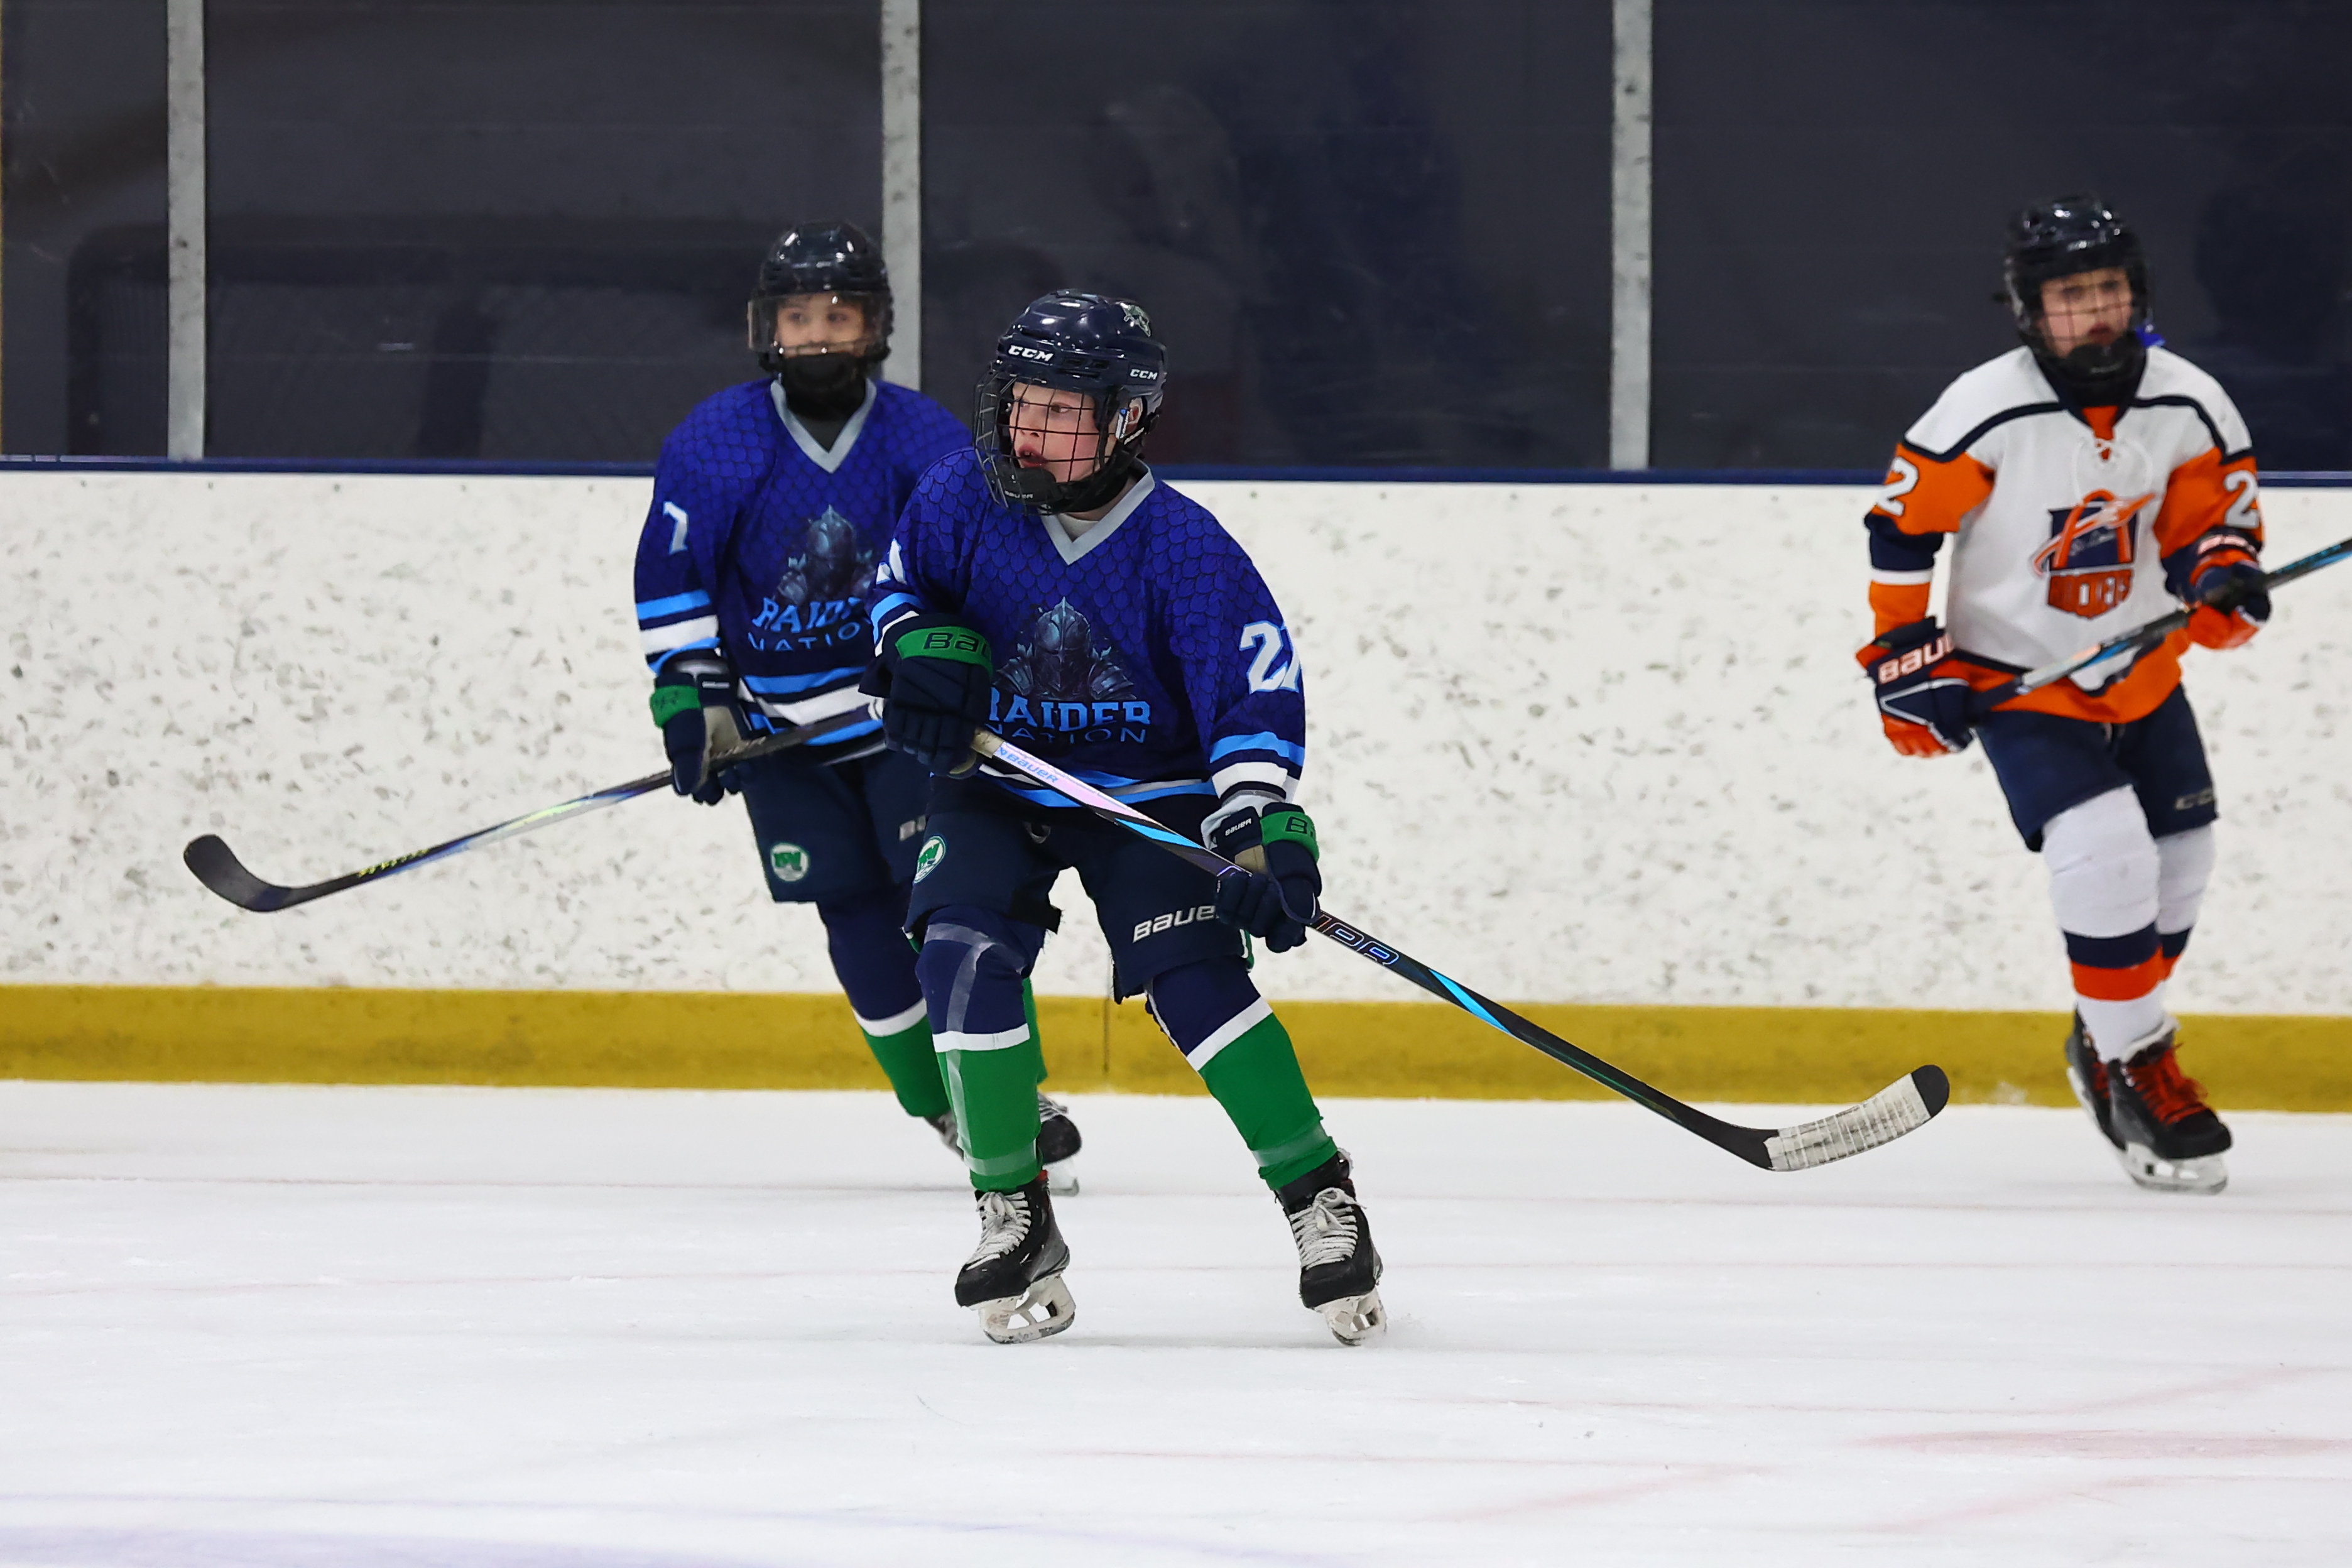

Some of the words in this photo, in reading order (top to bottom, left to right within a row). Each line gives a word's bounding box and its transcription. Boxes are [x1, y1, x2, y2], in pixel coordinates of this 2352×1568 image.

[1008, 345, 1054, 362] CCM
[1130, 369, 1158, 381] CCM
[2224, 469, 2260, 529] 2
[663, 501, 689, 554] 7
